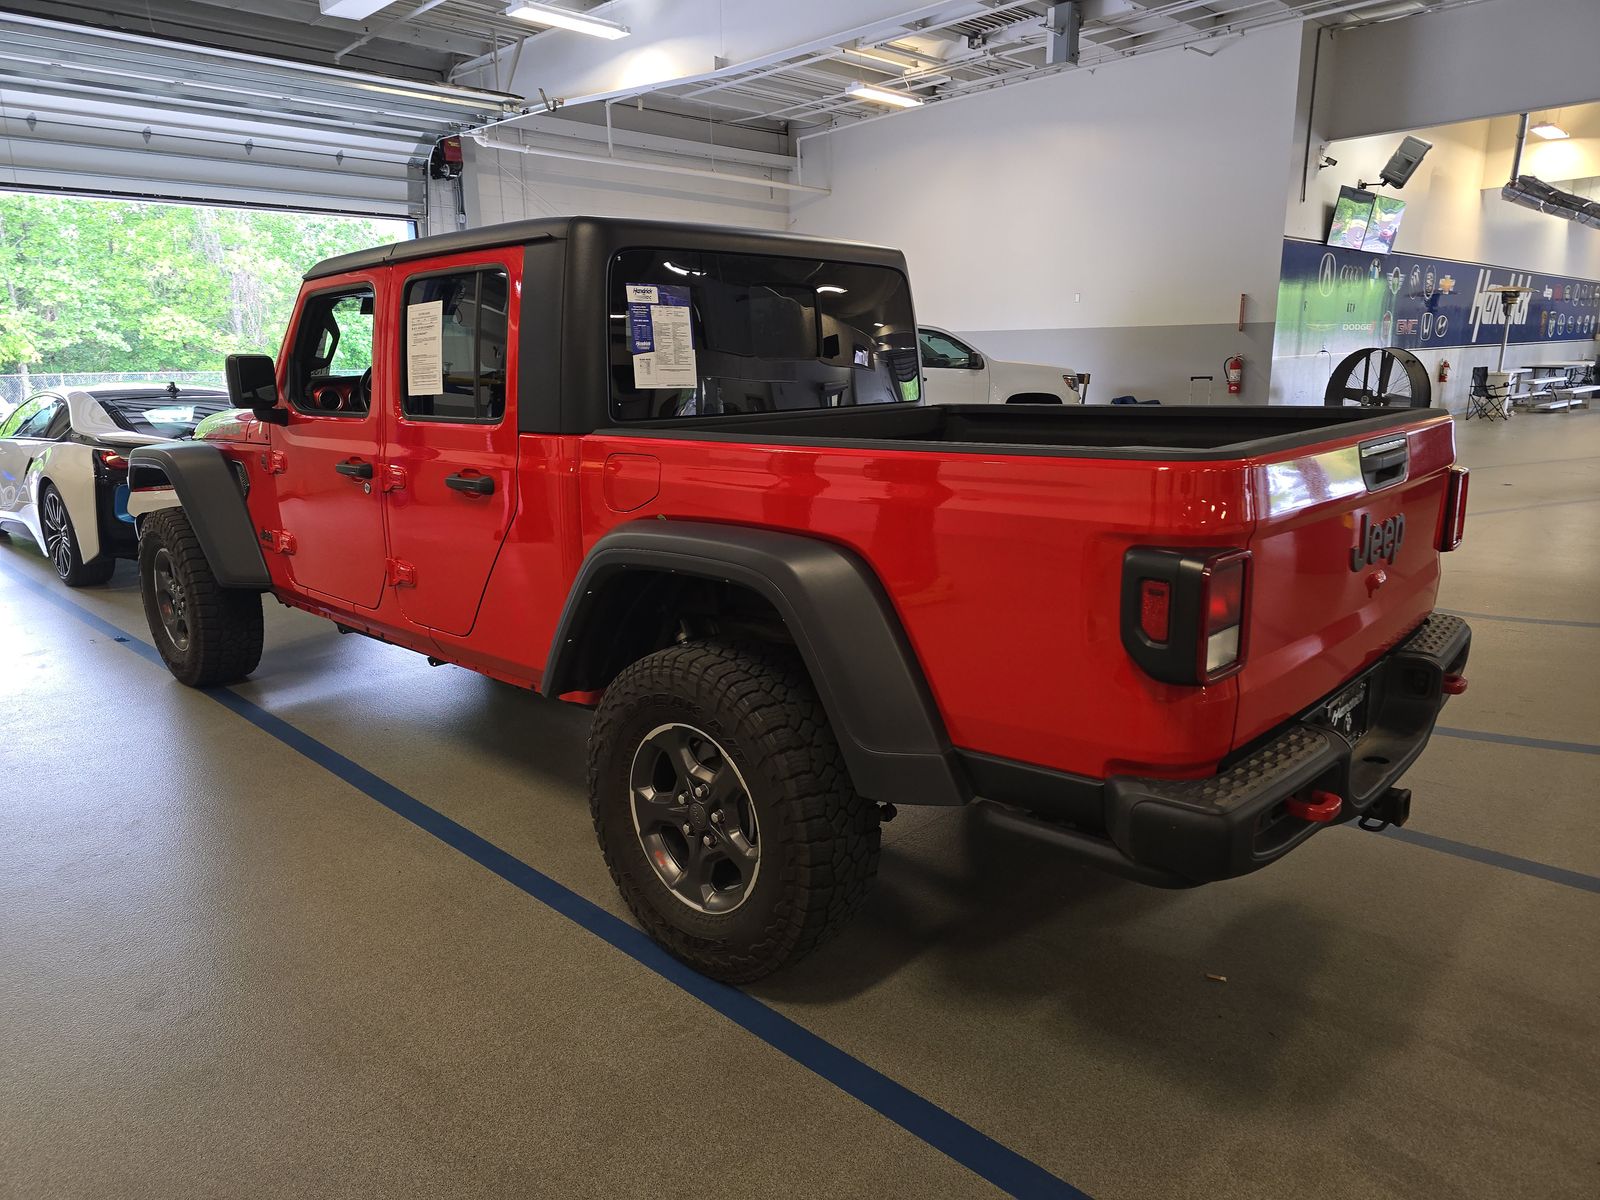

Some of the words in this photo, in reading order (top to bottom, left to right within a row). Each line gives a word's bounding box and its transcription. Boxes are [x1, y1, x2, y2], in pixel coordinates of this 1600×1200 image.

[1468, 268, 1531, 343] Hendick
[1342, 323, 1372, 331] DODGE
[1396, 319, 1419, 335] GMC
[1349, 512, 1406, 573] Jeep
